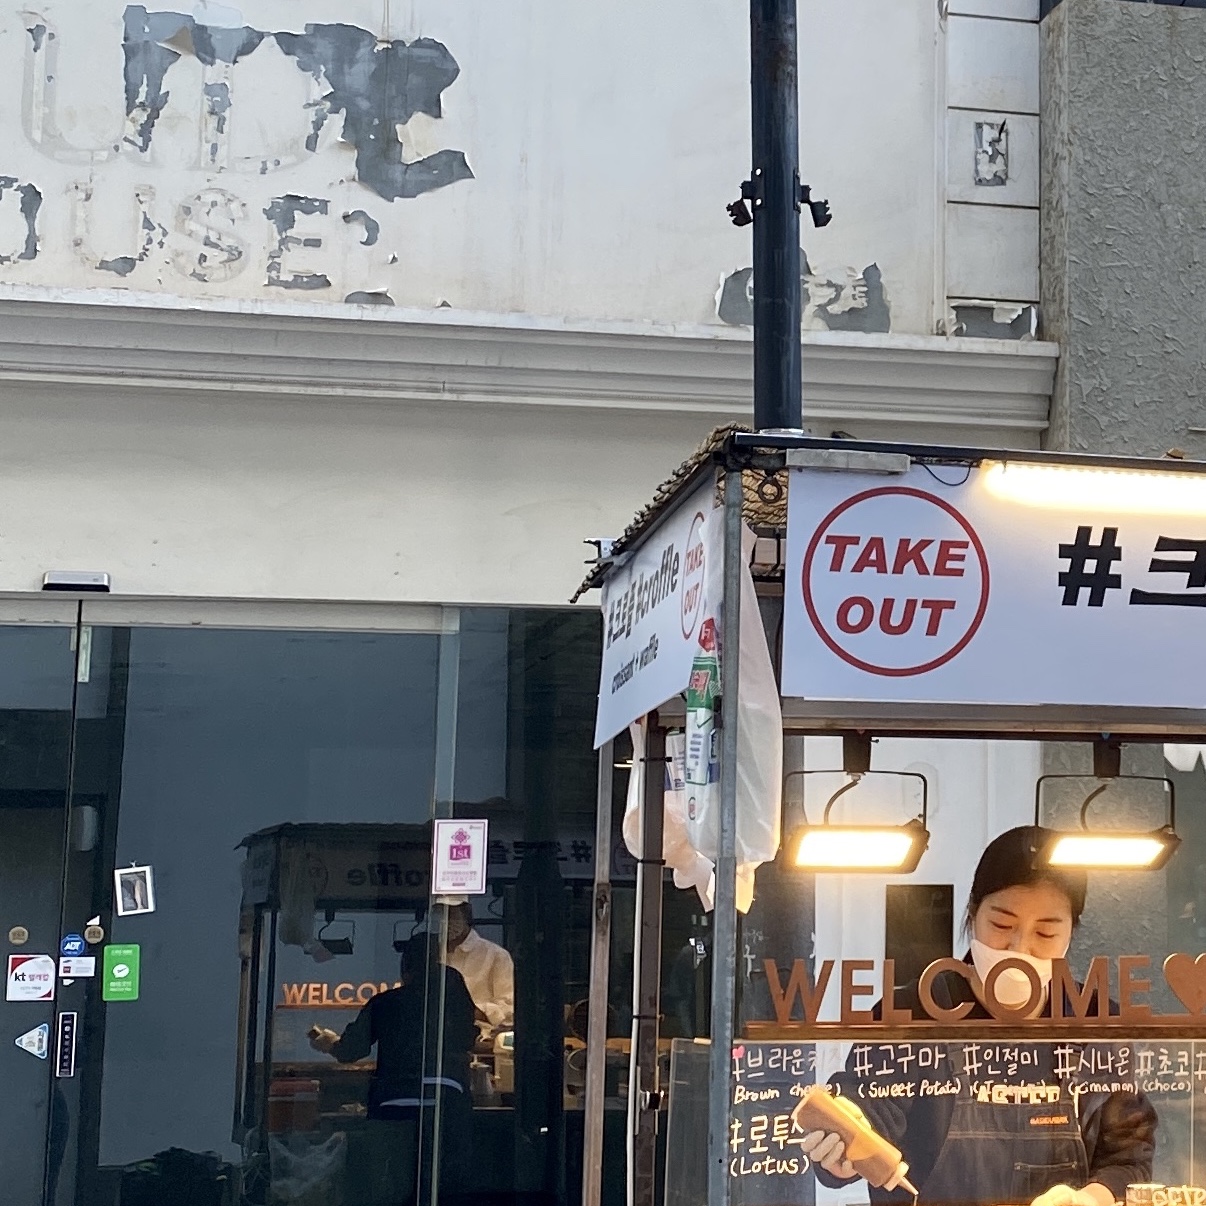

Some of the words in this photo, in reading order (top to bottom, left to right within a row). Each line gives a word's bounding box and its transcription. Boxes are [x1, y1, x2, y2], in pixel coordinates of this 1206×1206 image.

[824, 534, 970, 577] TAKE
[836, 595, 957, 637] OUT
[763, 957, 1152, 1024] WELCOME
[853, 1045, 946, 1078] #고구마
[962, 1043, 1039, 1076] #인절미
[1134, 1048, 1190, 1077] #초코
[730, 1154, 810, 1177] (Lotus)
